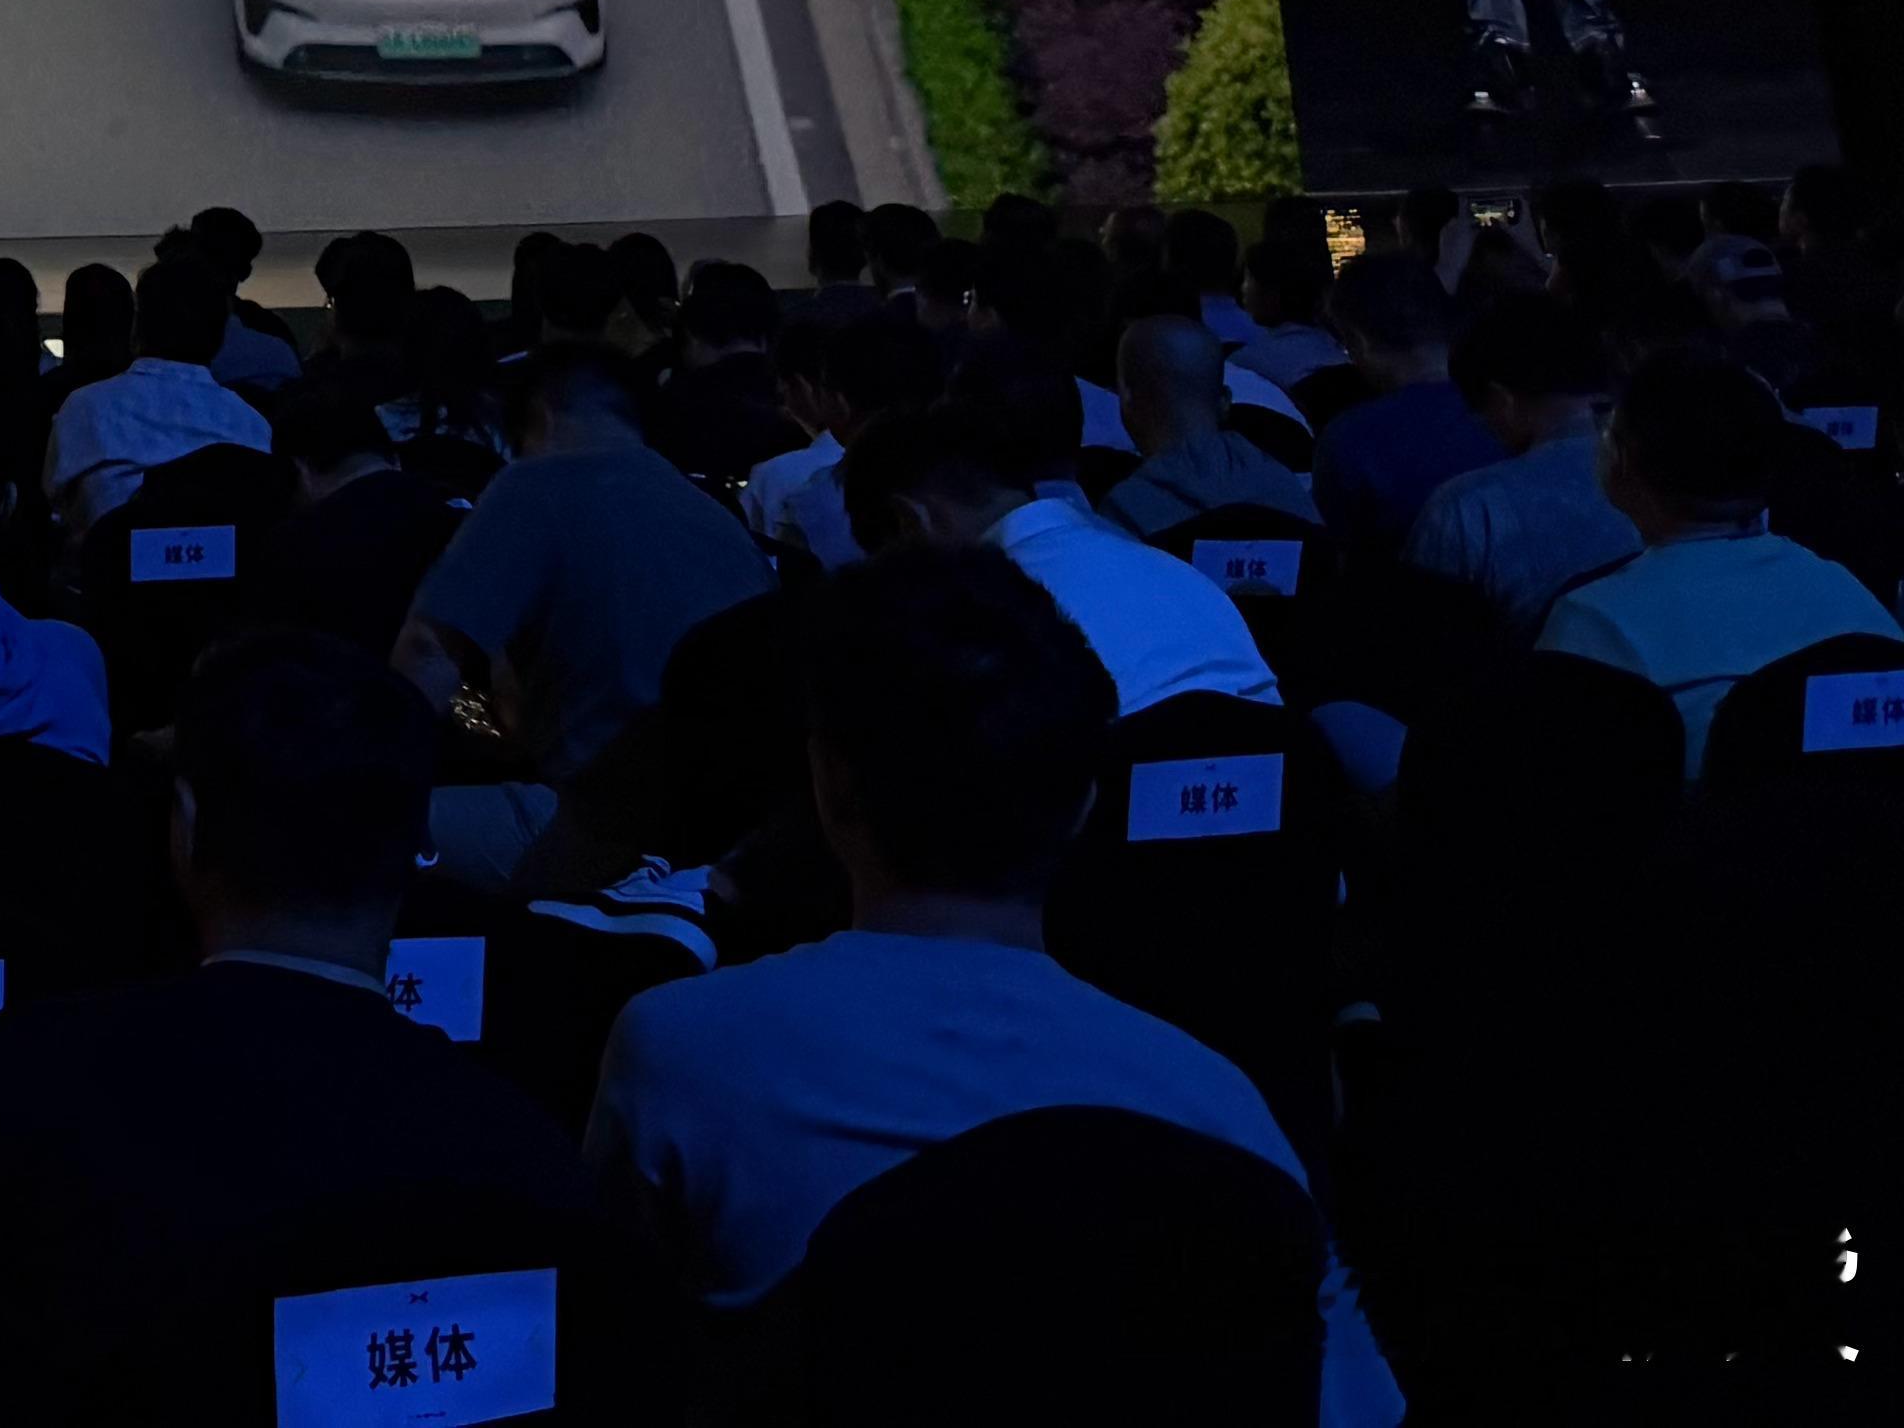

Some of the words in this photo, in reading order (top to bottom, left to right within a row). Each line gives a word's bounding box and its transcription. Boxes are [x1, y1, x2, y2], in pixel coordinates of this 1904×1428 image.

[1180, 783, 1239, 814] 媒体
[387, 972, 423, 1012] 体
[367, 1323, 478, 1390] 媒体
